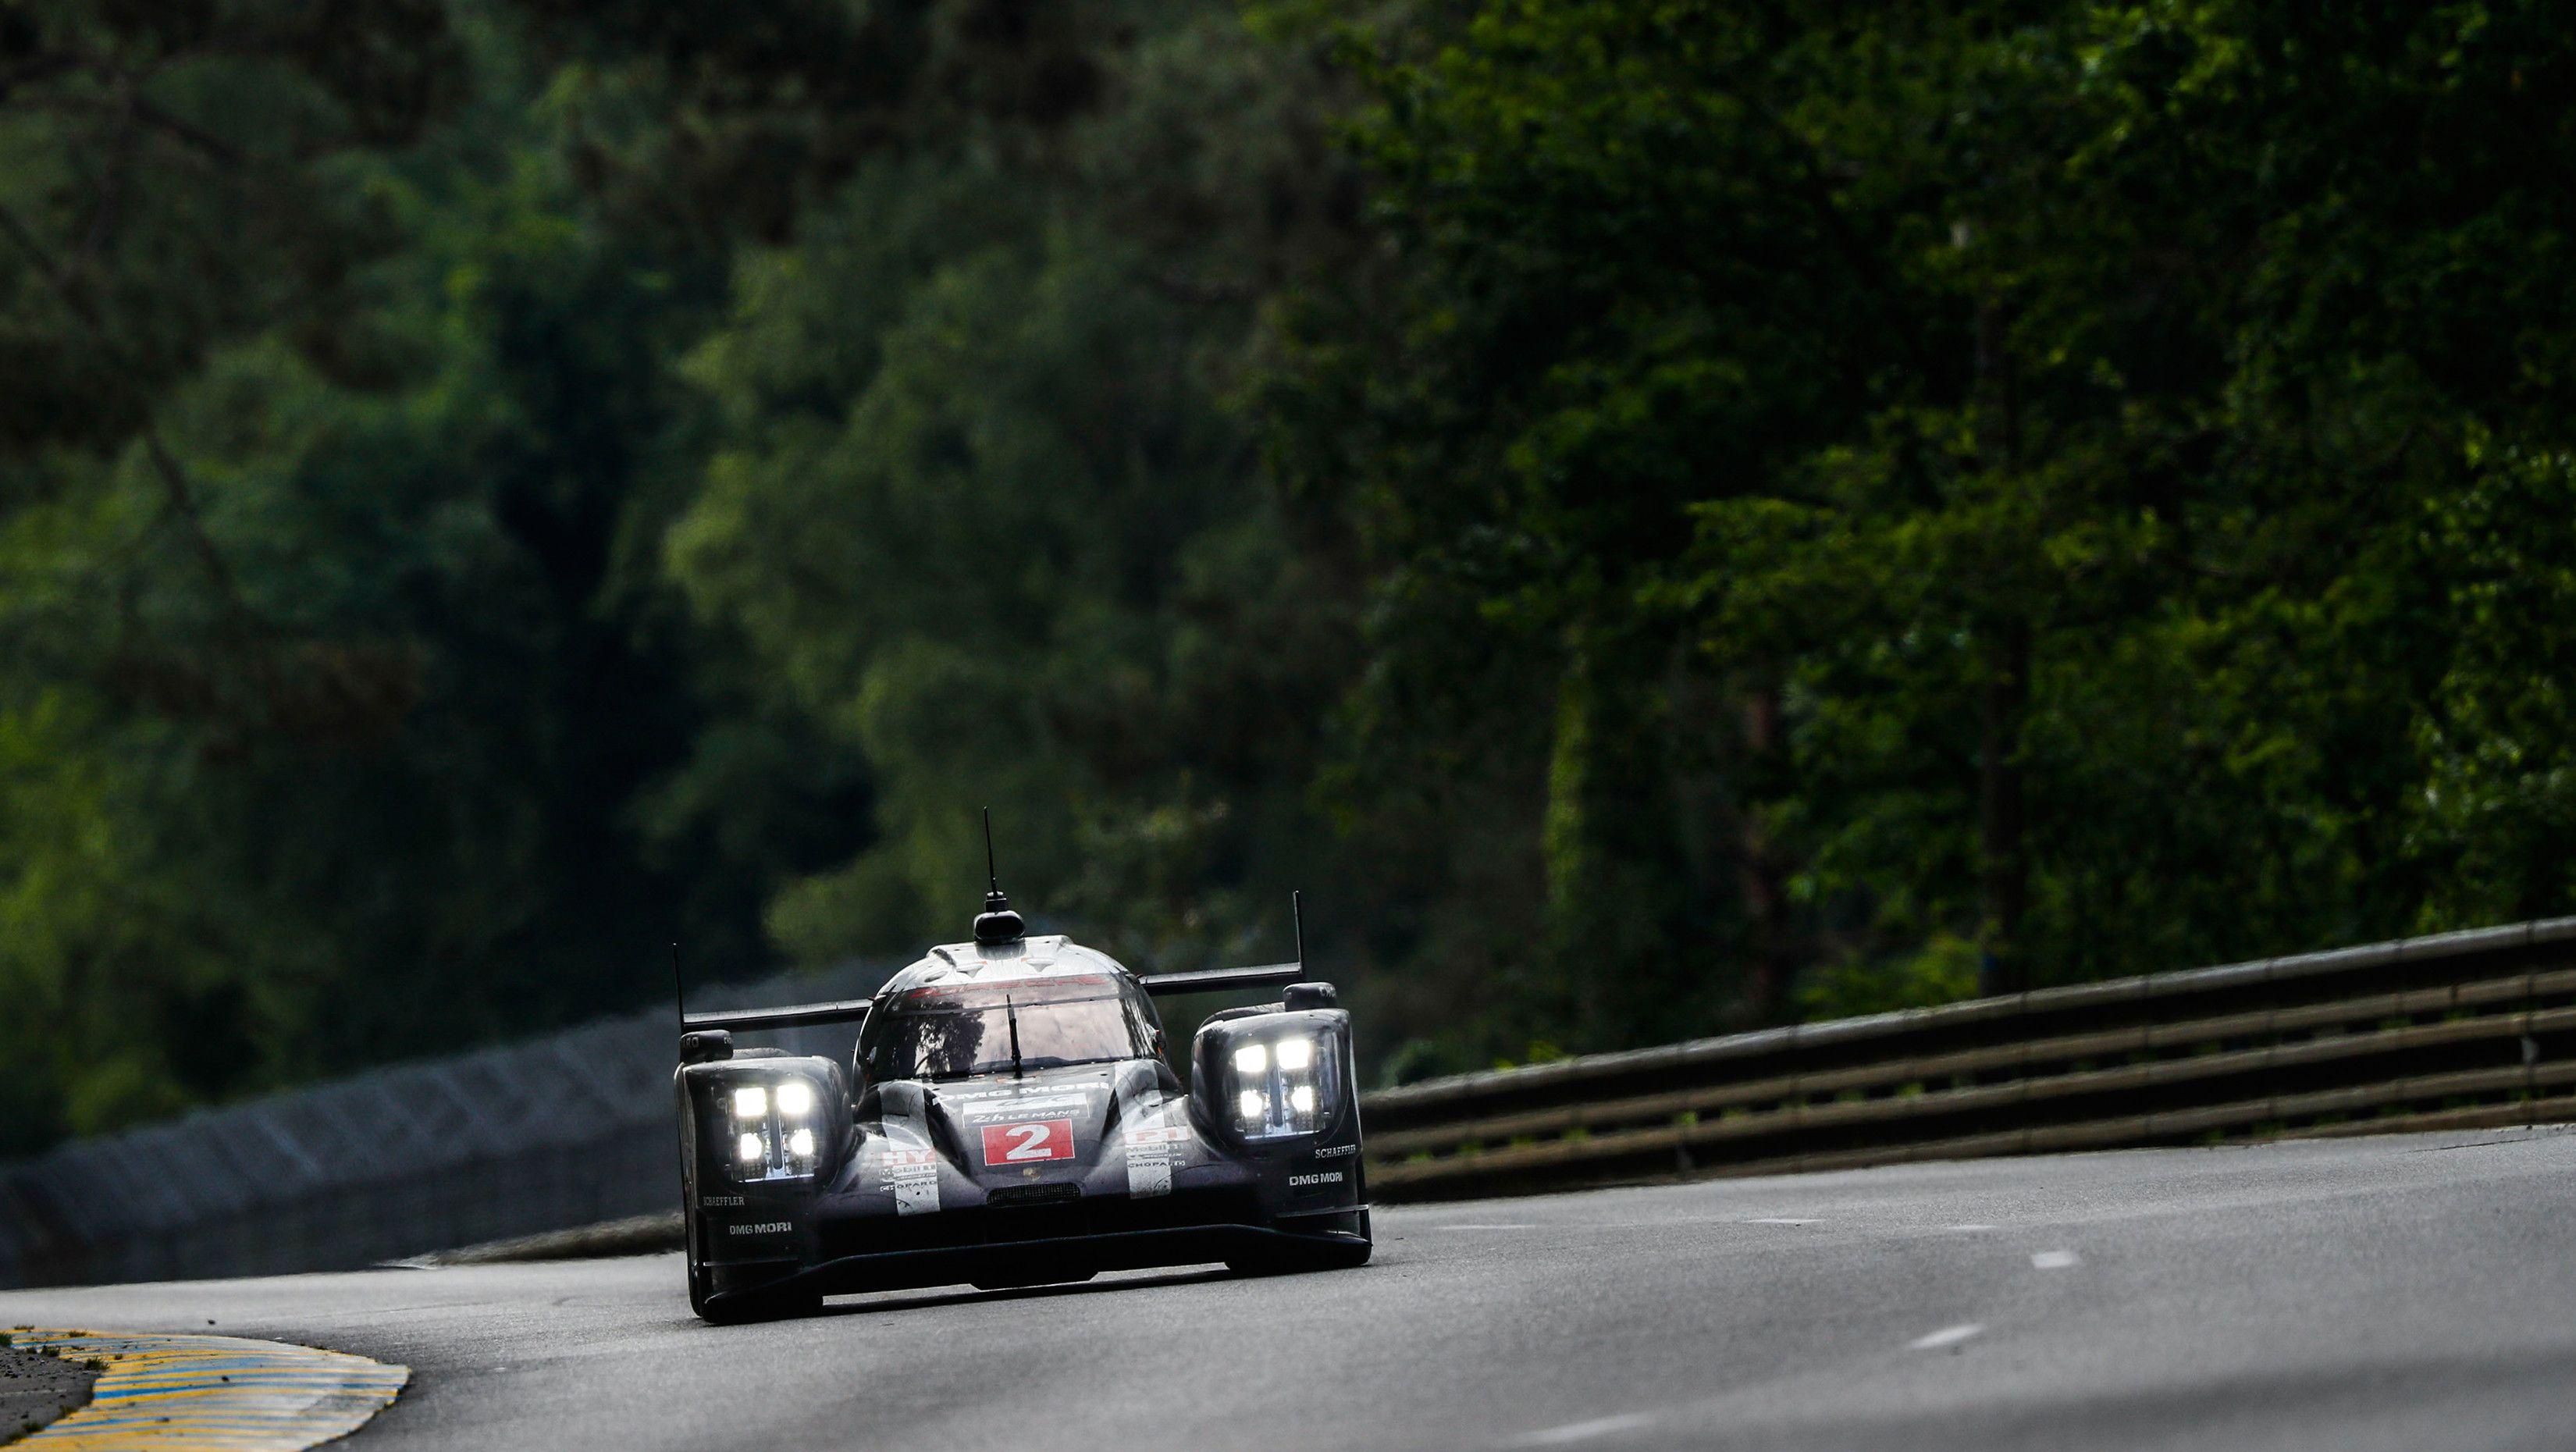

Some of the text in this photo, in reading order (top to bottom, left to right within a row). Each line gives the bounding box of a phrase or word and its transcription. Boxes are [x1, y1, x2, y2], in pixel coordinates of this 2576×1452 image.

[933, 1090, 1012, 1105] DMG
[1019, 1081, 1110, 1094] MORI
[1032, 1109, 1080, 1119] MANS
[1005, 1124, 1052, 1161] 2
[883, 1149, 934, 1166] HY
[1289, 1172, 1343, 1186] DMG MORI
[729, 1222, 792, 1235] DMG MORI
